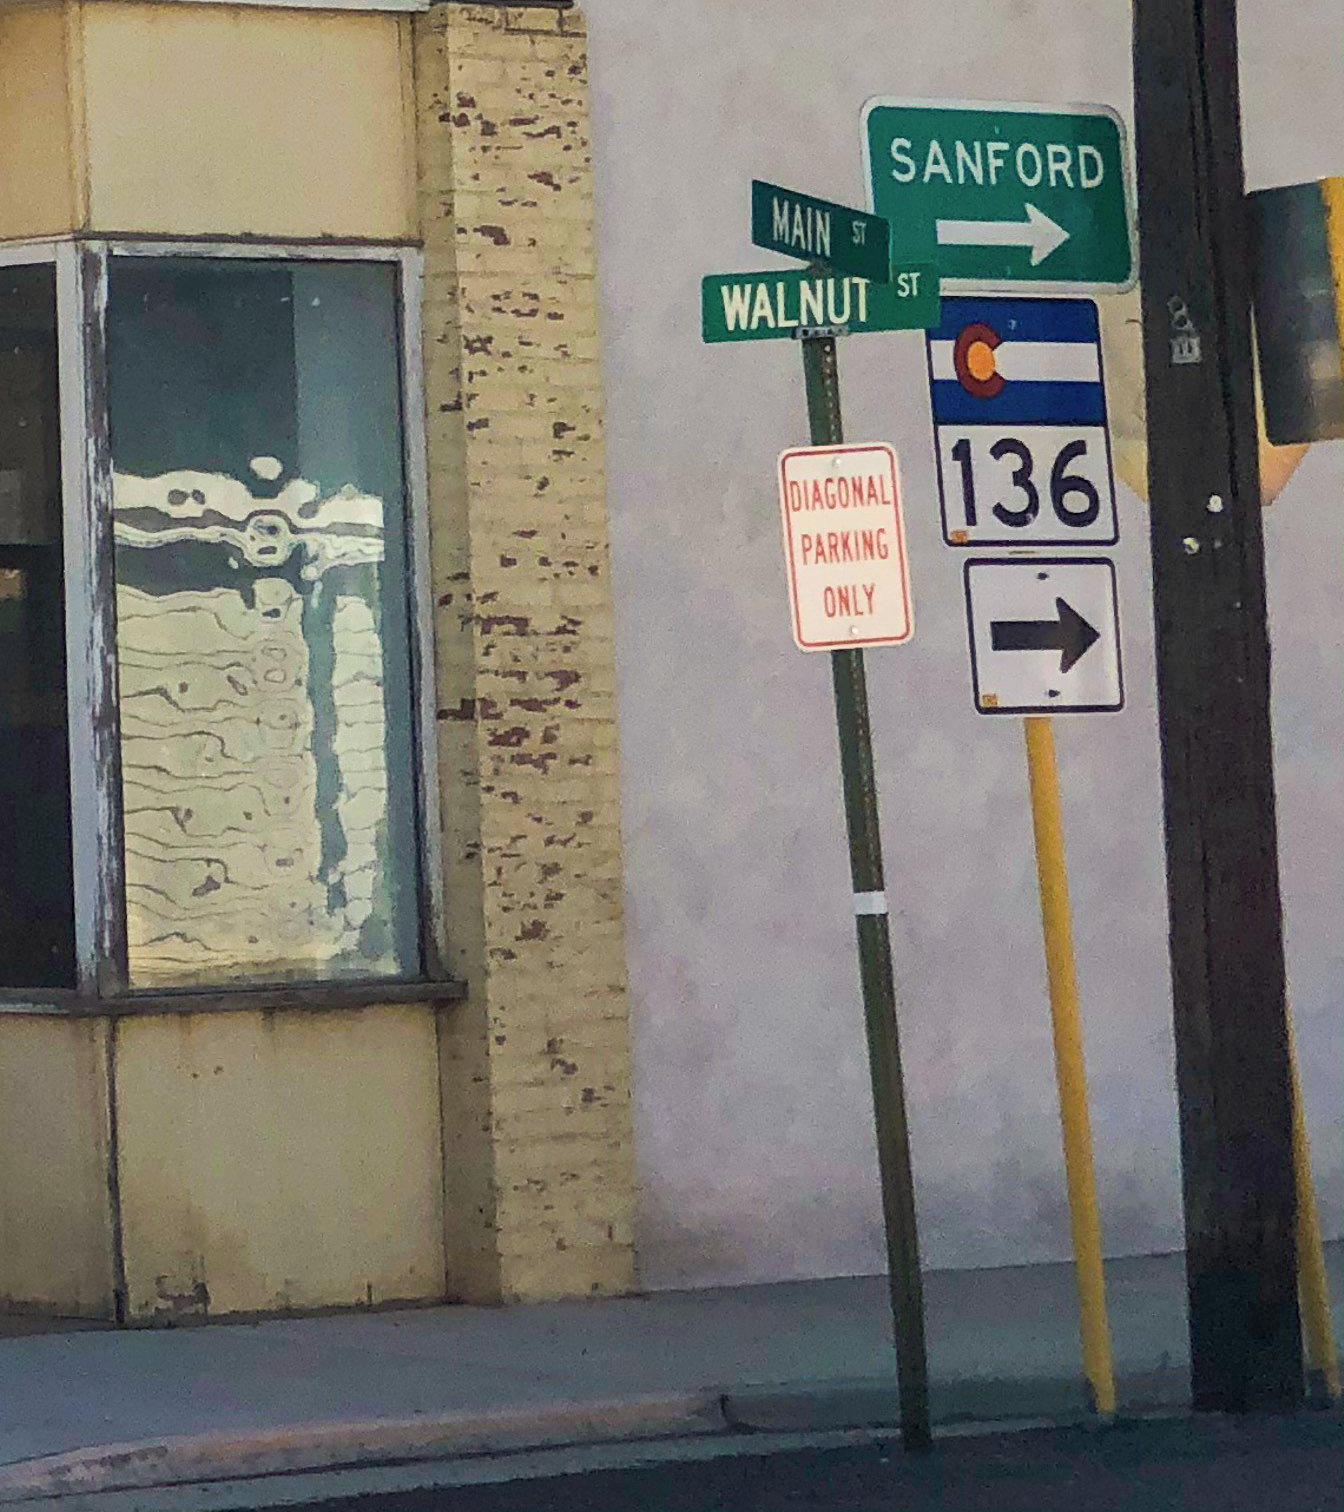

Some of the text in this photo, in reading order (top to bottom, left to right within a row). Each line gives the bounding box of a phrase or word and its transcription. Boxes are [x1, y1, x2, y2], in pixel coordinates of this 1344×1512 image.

[890, 137, 1104, 188] SANFORD
[772, 196, 867, 258] MAIN ST
[720, 272, 921, 331] WALNUT ST
[789, 475, 891, 512] DIAGONAL
[951, 437, 1100, 527] 136
[801, 528, 889, 565] PARKING
[823, 582, 875, 618] ONLY
